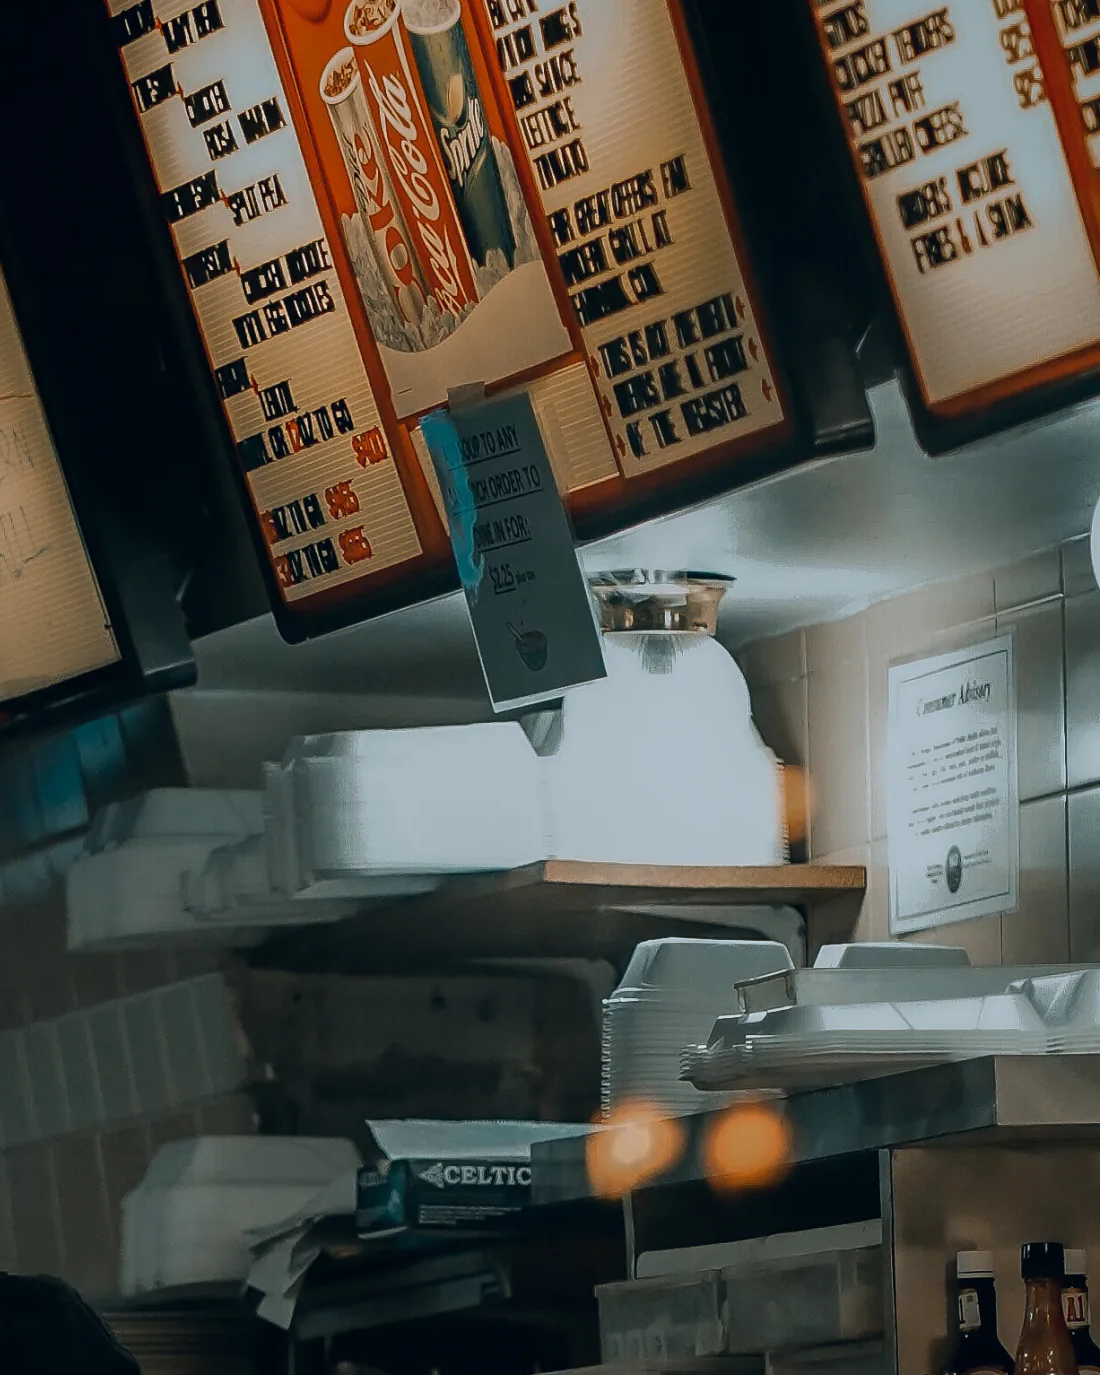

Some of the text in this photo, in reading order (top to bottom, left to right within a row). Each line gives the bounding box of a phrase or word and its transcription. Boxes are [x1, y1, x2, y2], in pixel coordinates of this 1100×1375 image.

[440, 96, 485, 187] Sprite
[480, 430, 496, 456] TO
[495, 424, 520, 453] ANY
[487, 468, 525, 499] ORDER
[522, 464, 542, 488] TO
[443, 1165, 533, 1187] CELTIC
